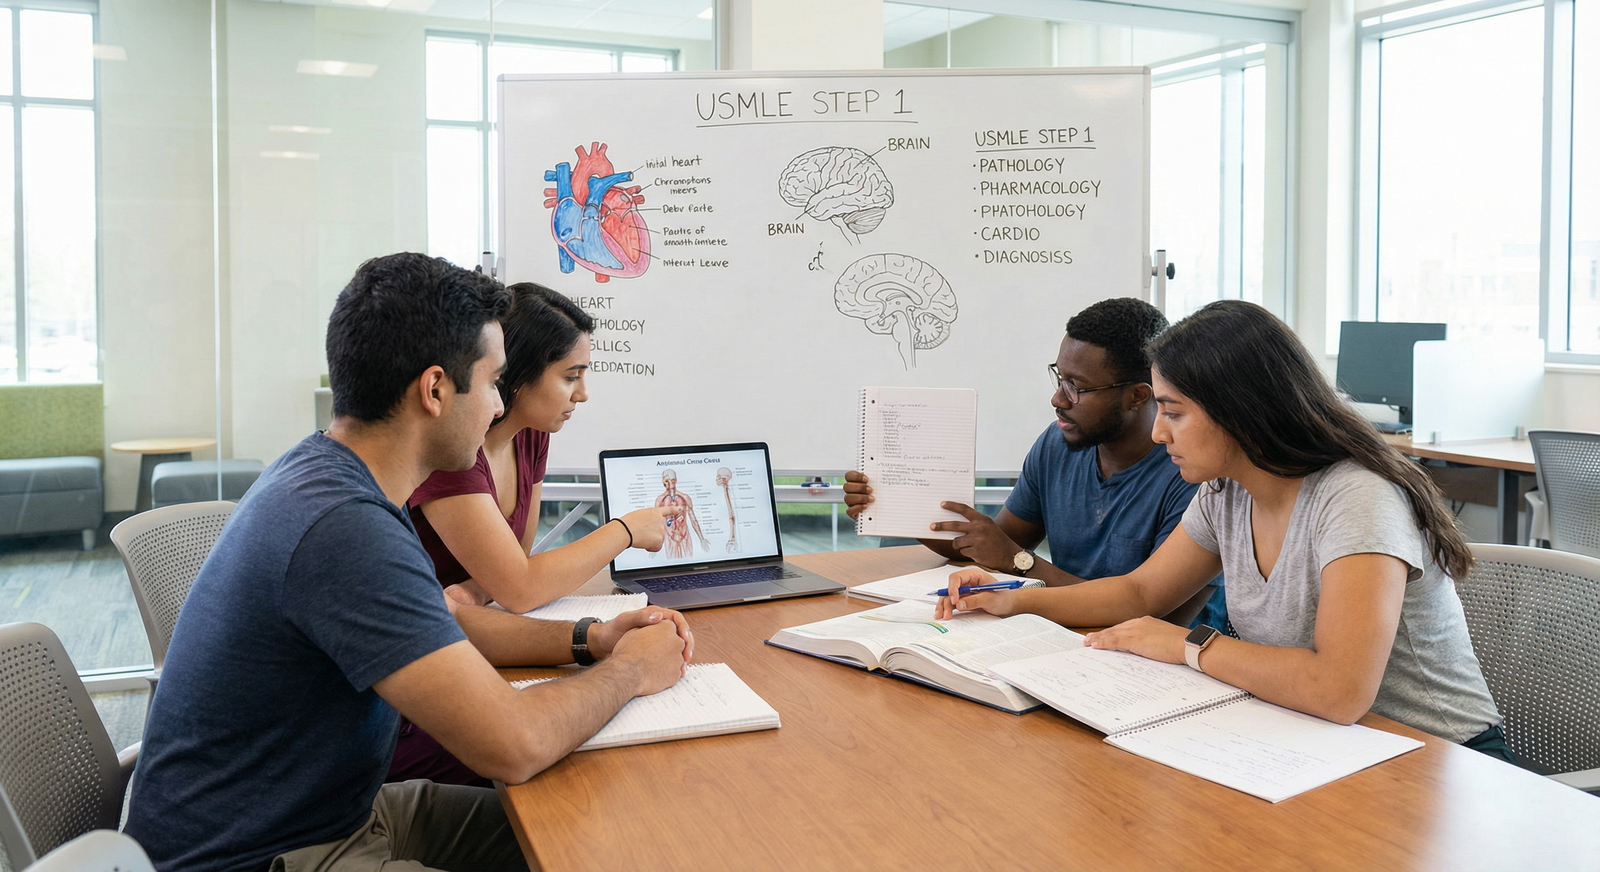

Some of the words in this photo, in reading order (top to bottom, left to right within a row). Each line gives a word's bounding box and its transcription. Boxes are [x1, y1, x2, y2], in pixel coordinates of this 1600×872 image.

[696, 92, 793, 120] USMLE
[813, 90, 879, 114] STEP
[894, 89, 912, 114] 1
[975, 130, 1029, 146] USMLE
[1039, 127, 1078, 143] STEP
[1084, 127, 1094, 142] 1
[888, 137, 930, 151] BRAIN
[671, 154, 703, 168] heart
[980, 158, 1065, 174] PATHOLOGY
[980, 180, 1101, 197] PHARMACOLOGY
[981, 204, 1085, 220] PHATOHOLOGY
[694, 225, 706, 235] of
[768, 223, 804, 236] BRAIN
[981, 227, 1040, 241] CARDIO
[984, 250, 1072, 264] DIAGNOSISS
